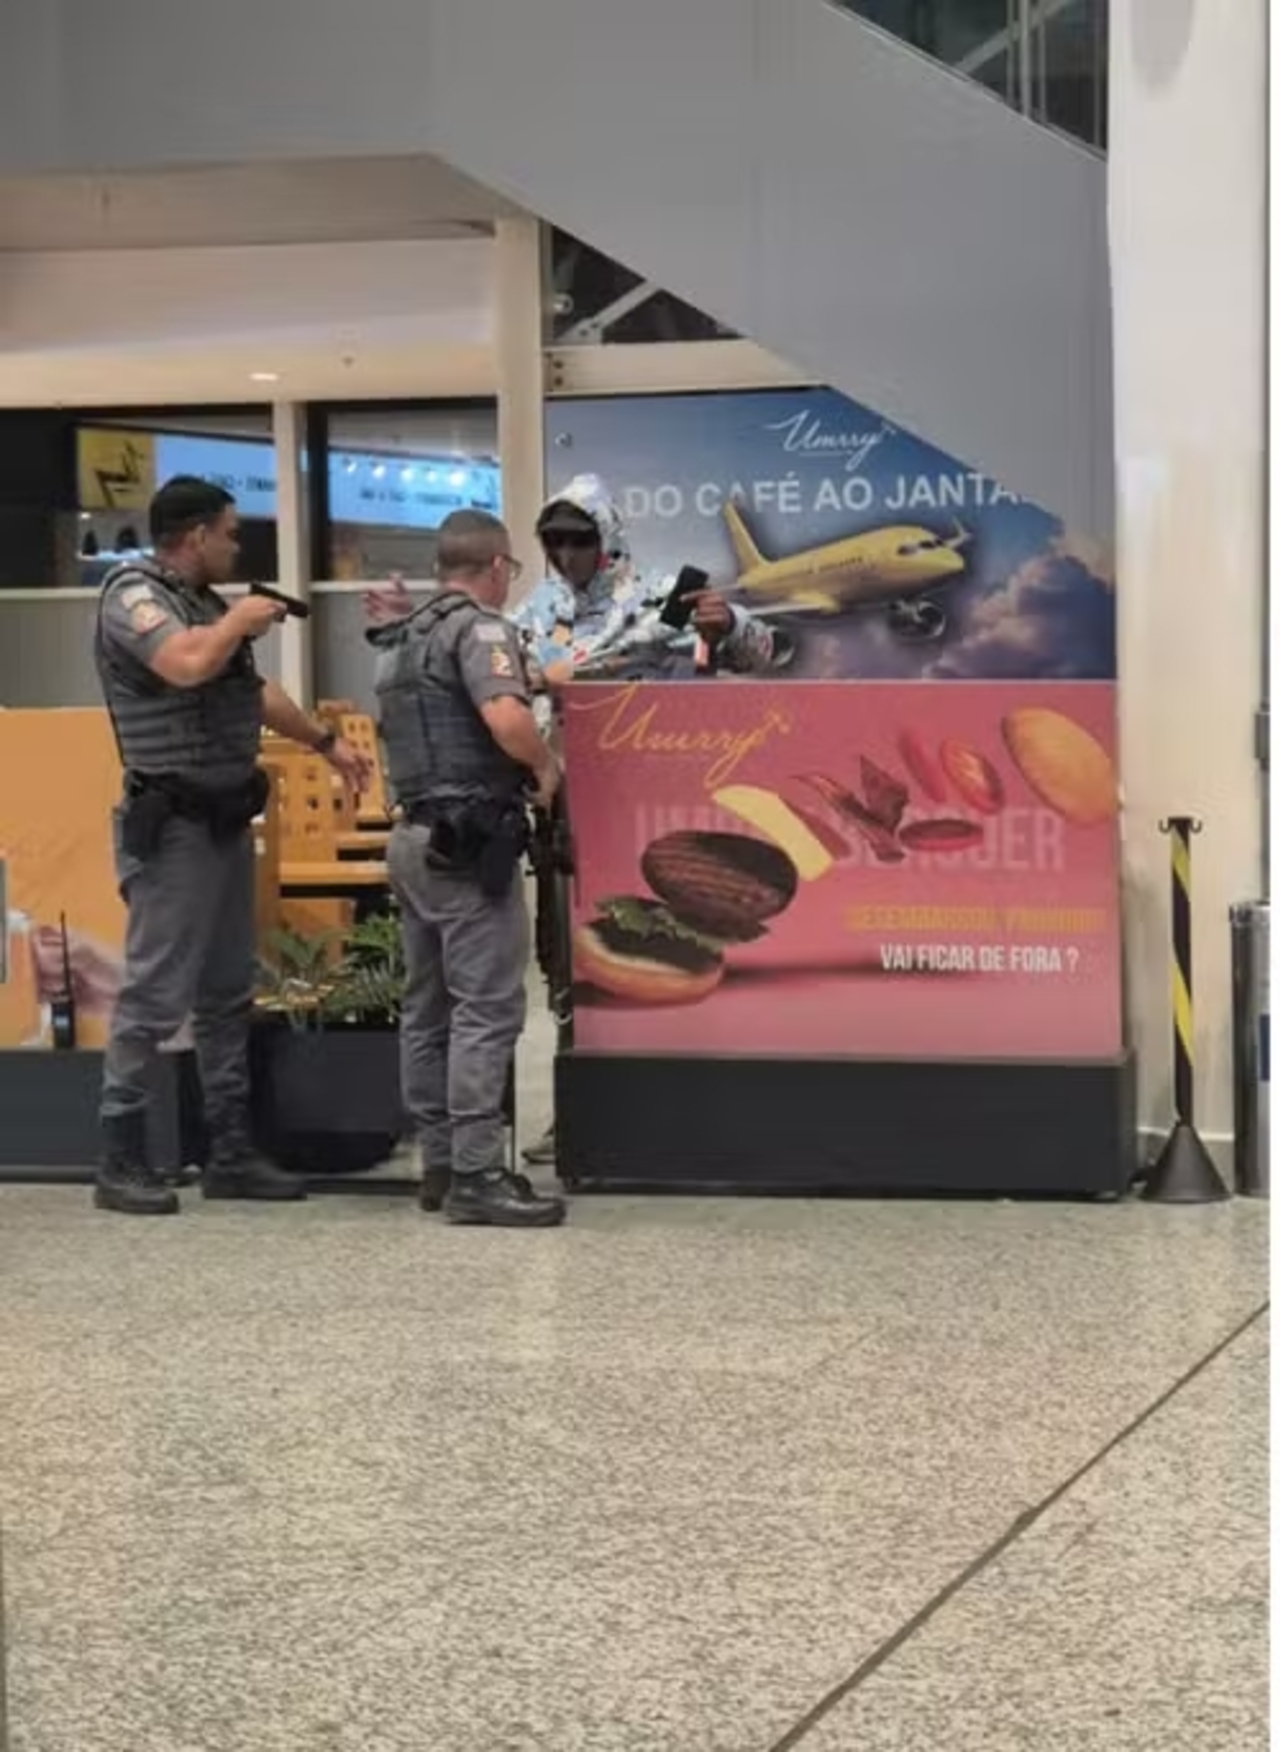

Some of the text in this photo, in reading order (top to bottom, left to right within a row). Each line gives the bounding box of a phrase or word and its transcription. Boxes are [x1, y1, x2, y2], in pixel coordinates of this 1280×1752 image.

[625, 484, 682, 518] DO
[814, 476, 872, 512] AO
[886, 471, 1032, 511] JANTA
[880, 943, 1080, 974] VAI FICAR DE FORA ?
